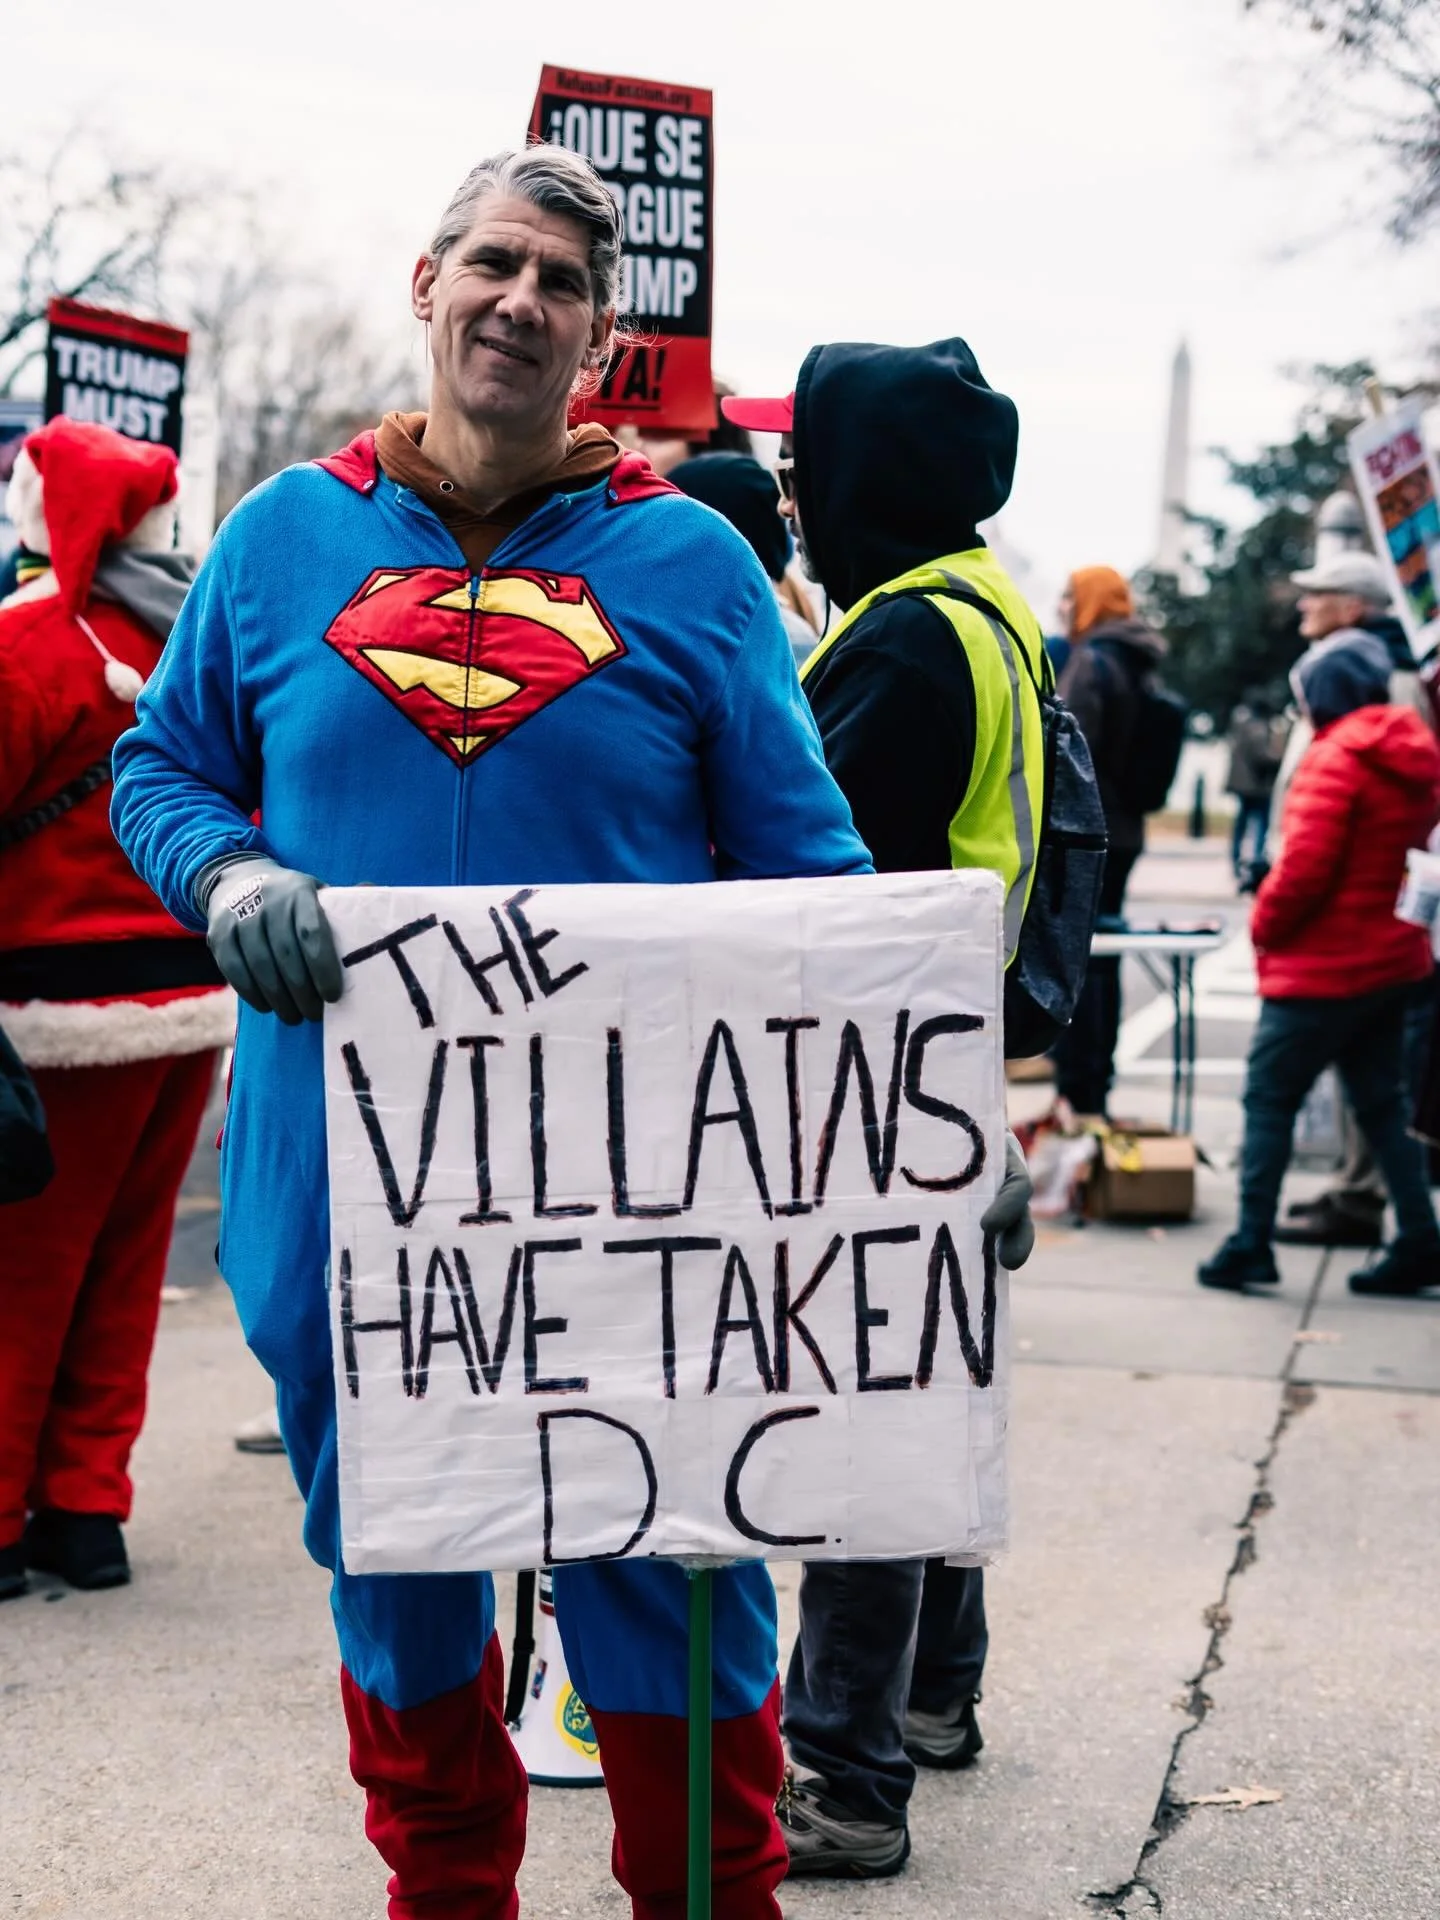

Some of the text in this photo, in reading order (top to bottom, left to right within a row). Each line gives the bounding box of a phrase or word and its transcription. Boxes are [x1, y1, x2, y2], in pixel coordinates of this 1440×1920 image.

[654, 114, 704, 181] SE
[616, 255, 698, 318] UMP
[52, 335, 181, 400] TRUMP
[63, 382, 168, 442] MUST
[341, 888, 589, 1028] THE
[340, 1008, 988, 1228] VILLAINS
[340, 1222, 997, 1400] HAVE TAKEN
